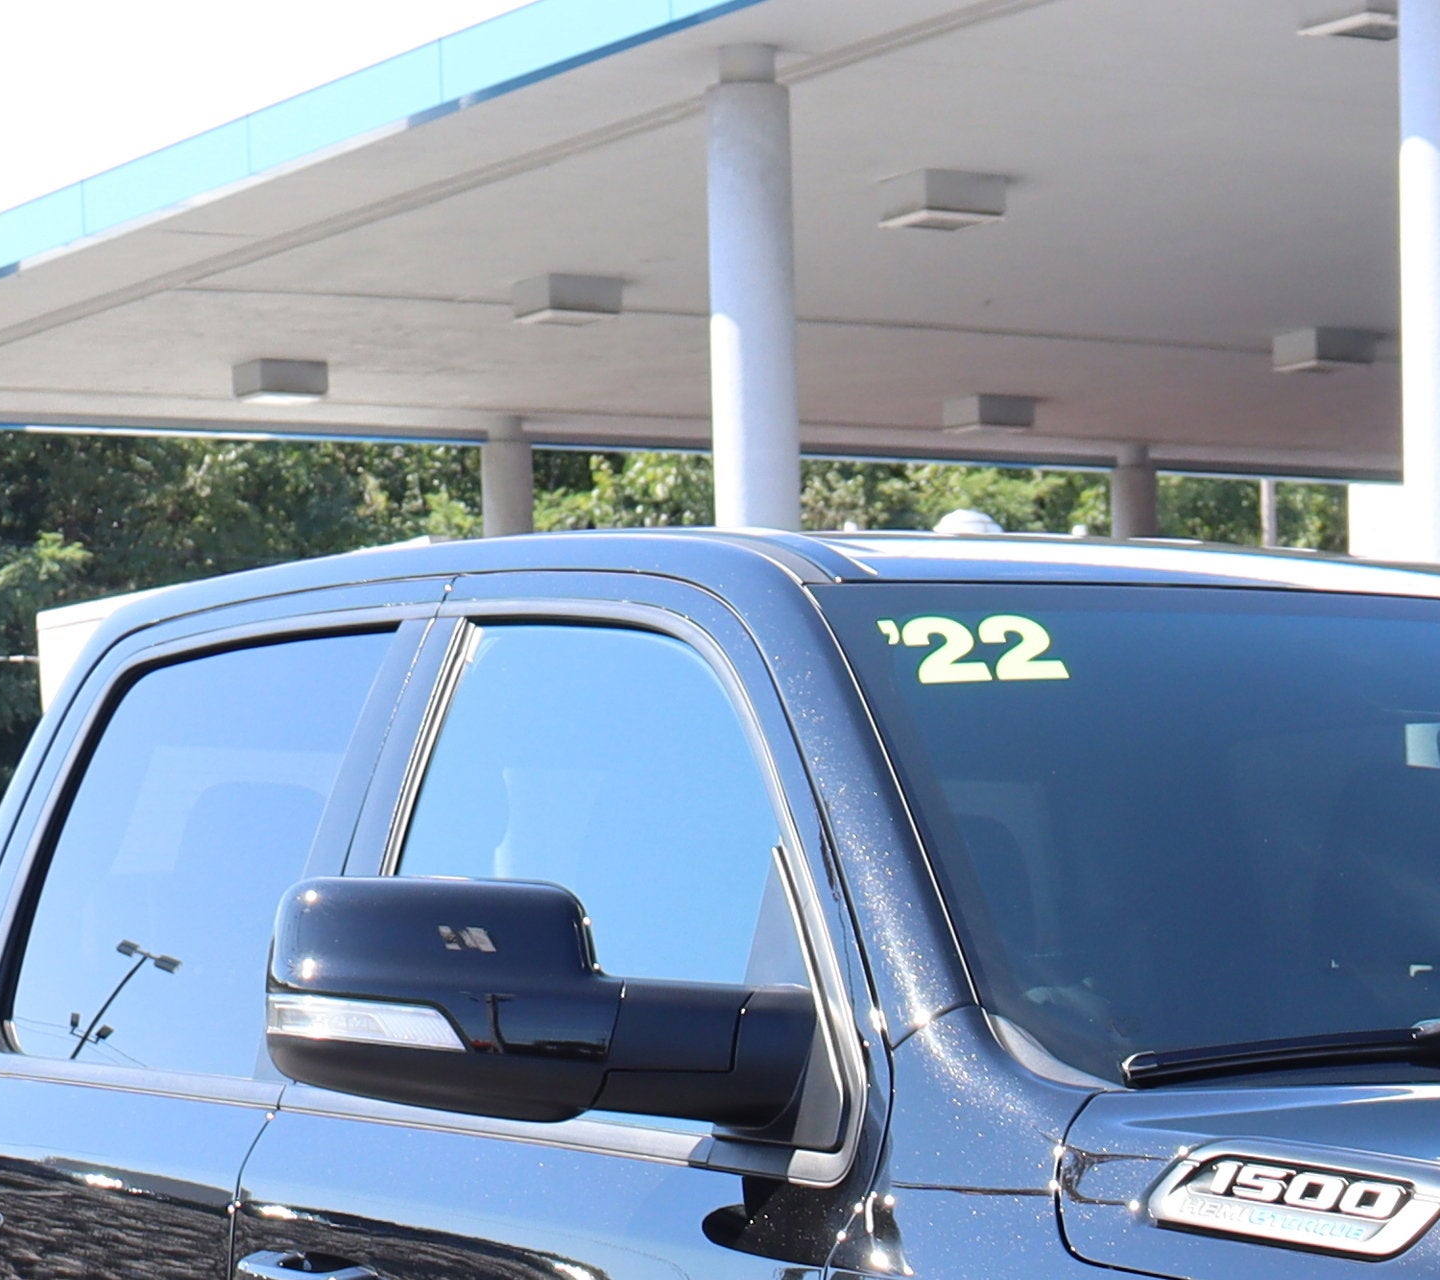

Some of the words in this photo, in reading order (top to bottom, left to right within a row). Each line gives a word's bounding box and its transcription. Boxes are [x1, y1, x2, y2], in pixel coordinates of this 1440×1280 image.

[876, 613, 1070, 684] '22
[1178, 1197, 1249, 1223] HEMI
[1211, 1161, 1408, 1220] 1500
